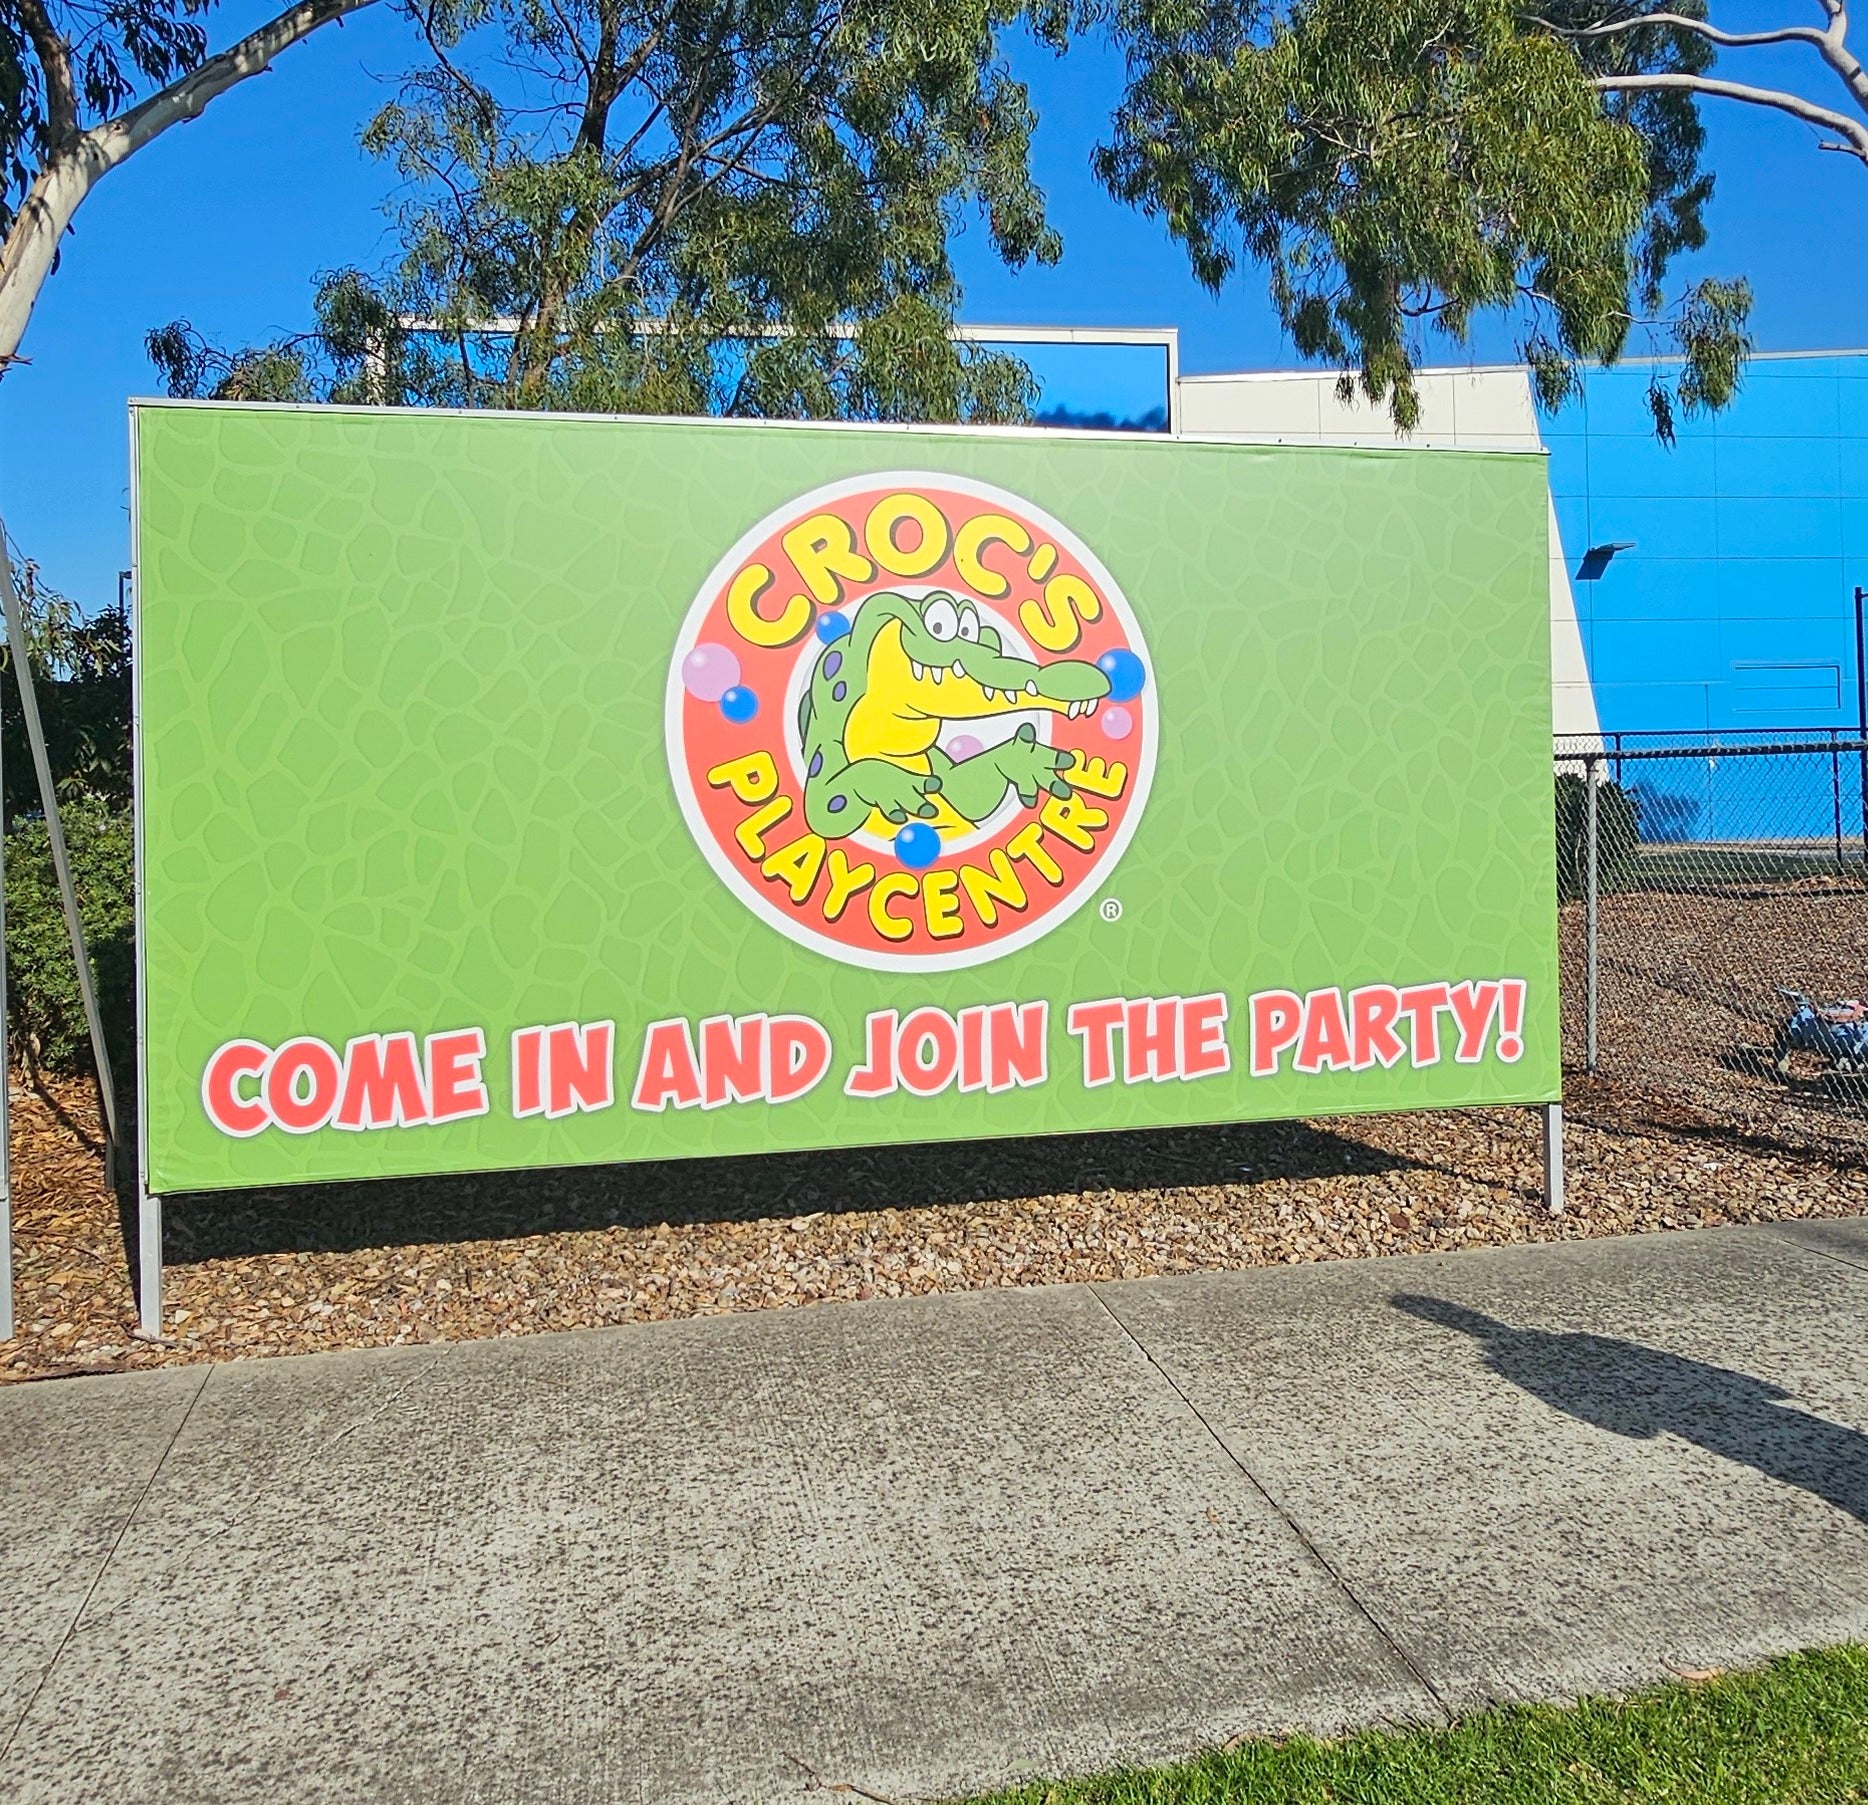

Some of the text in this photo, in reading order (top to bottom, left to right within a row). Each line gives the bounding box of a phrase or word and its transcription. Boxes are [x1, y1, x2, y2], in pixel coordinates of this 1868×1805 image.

[726, 493, 1101, 652] CROC'S
[707, 748, 1127, 941] PLAYCENTRE
[204, 980, 1526, 1136] COME IN AND JOIN THE PARTY!
